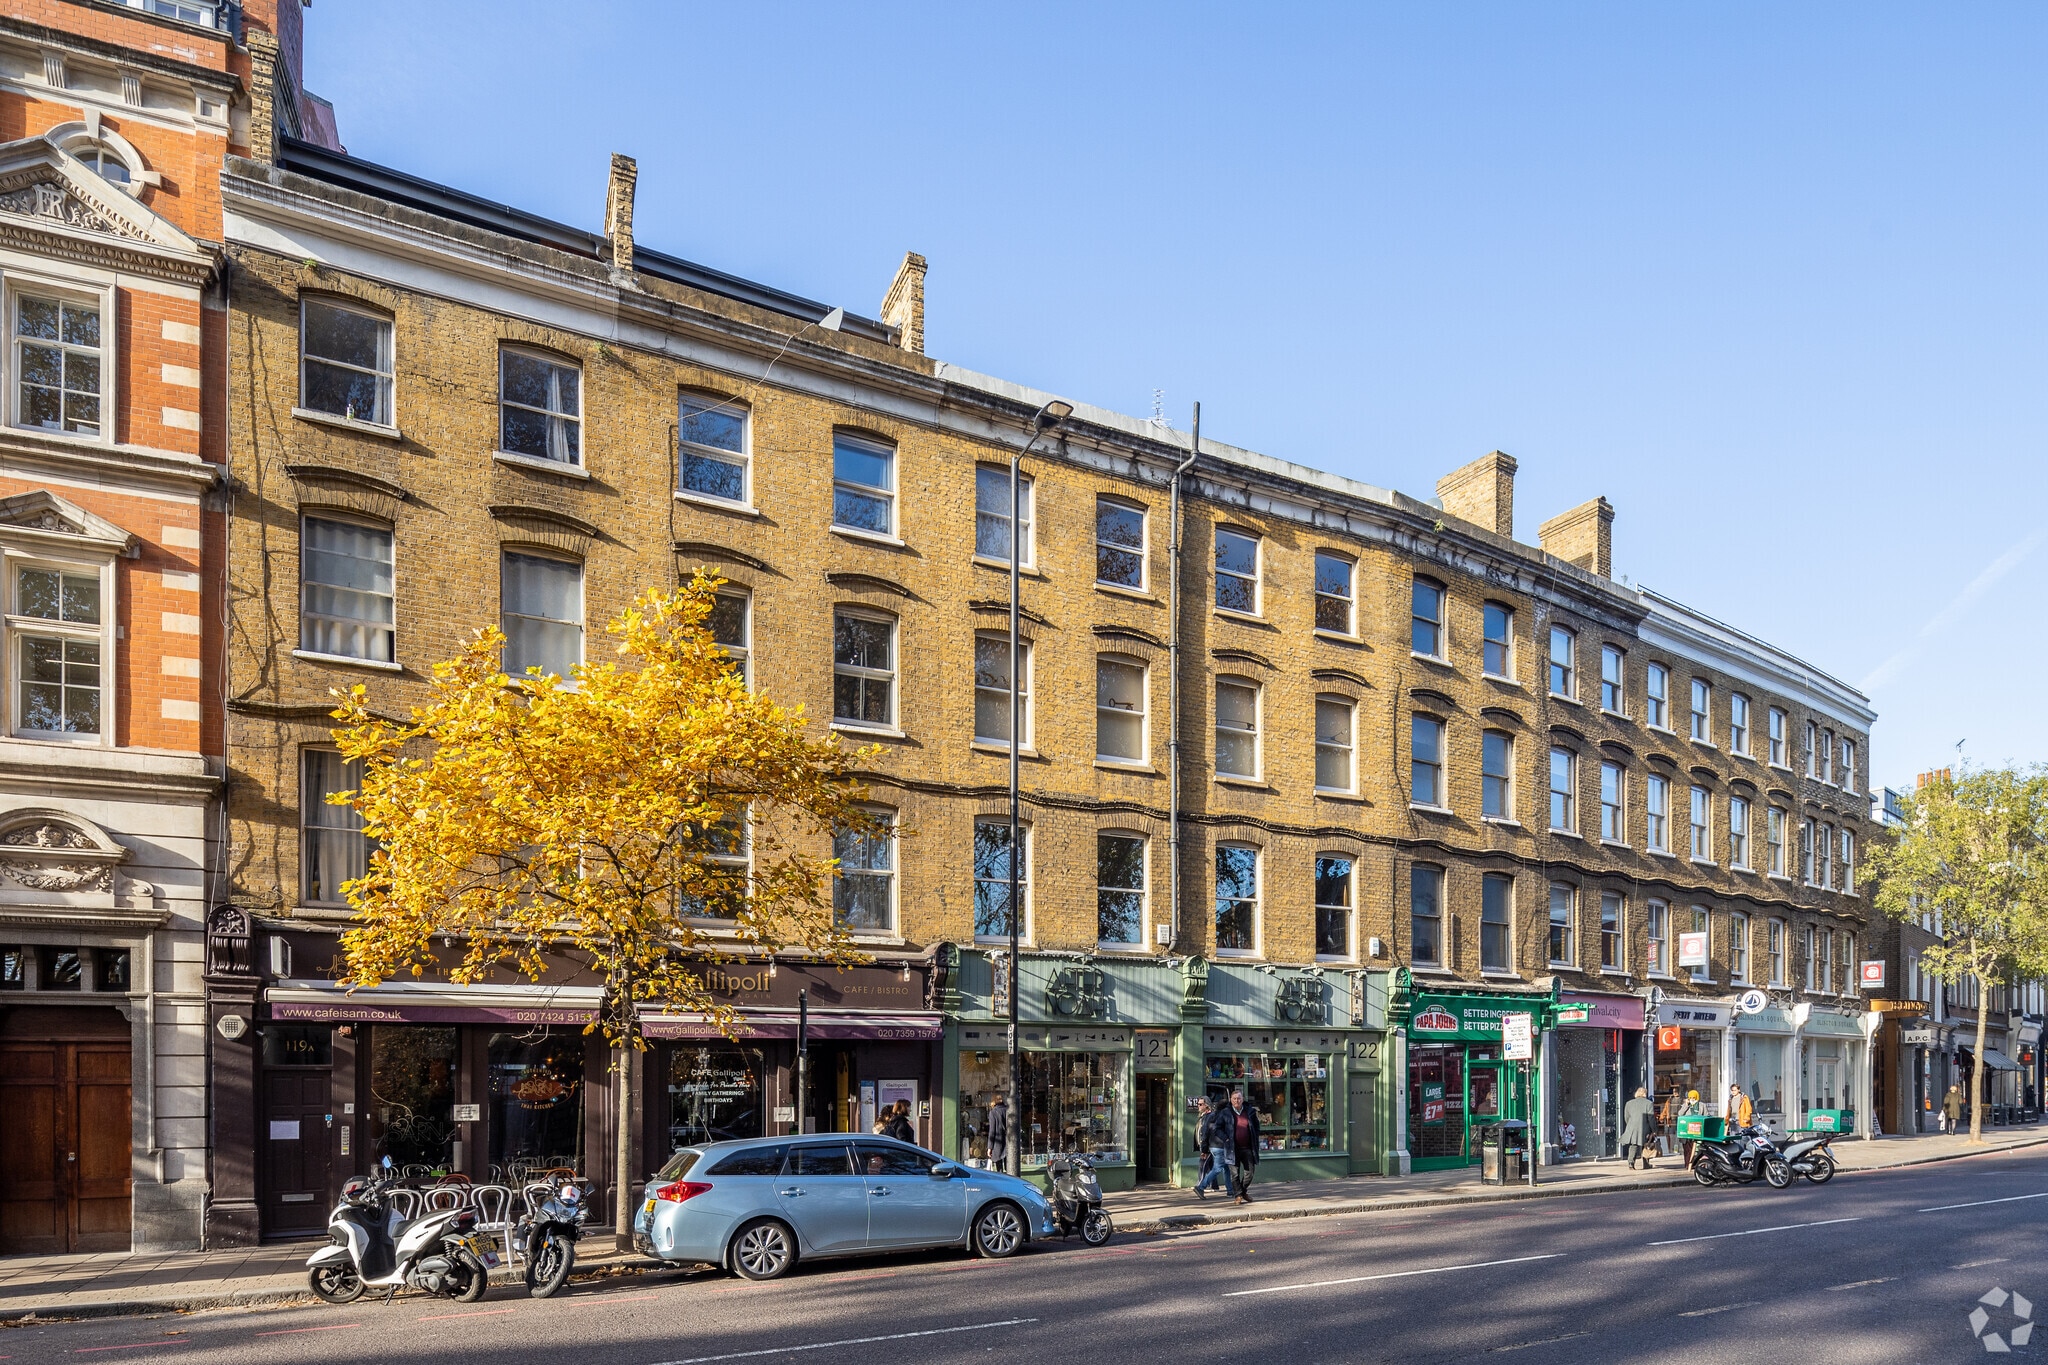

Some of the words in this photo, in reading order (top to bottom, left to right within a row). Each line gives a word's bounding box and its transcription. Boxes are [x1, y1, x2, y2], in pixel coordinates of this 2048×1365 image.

[695, 970, 770, 995] allipoli
[843, 986, 868, 994] CAFE
[878, 987, 908, 995] BISTRO
[283, 1008, 401, 1019] www.cafeisarn.co.uk
[517, 1012, 537, 1021] 020
[540, 1012, 564, 1021] 7424
[1463, 1008, 1489, 1018] BETTER
[1416, 1014, 1434, 1029] PAPA
[1435, 1013, 1457, 1029] JOHNS
[1463, 1021, 1489, 1030] BETTER
[1490, 1022, 1503, 1031] PIZZ
[651, 1026, 756, 1035] www.gallipolica.co.uk
[878, 1029, 893, 1037] 020
[895, 1030, 915, 1038] 7359
[918, 1030, 936, 1038] 1578
[1138, 1039, 1170, 1057] 121
[1350, 1042, 1378, 1059] 122
[484, 1253, 496, 1265] L
